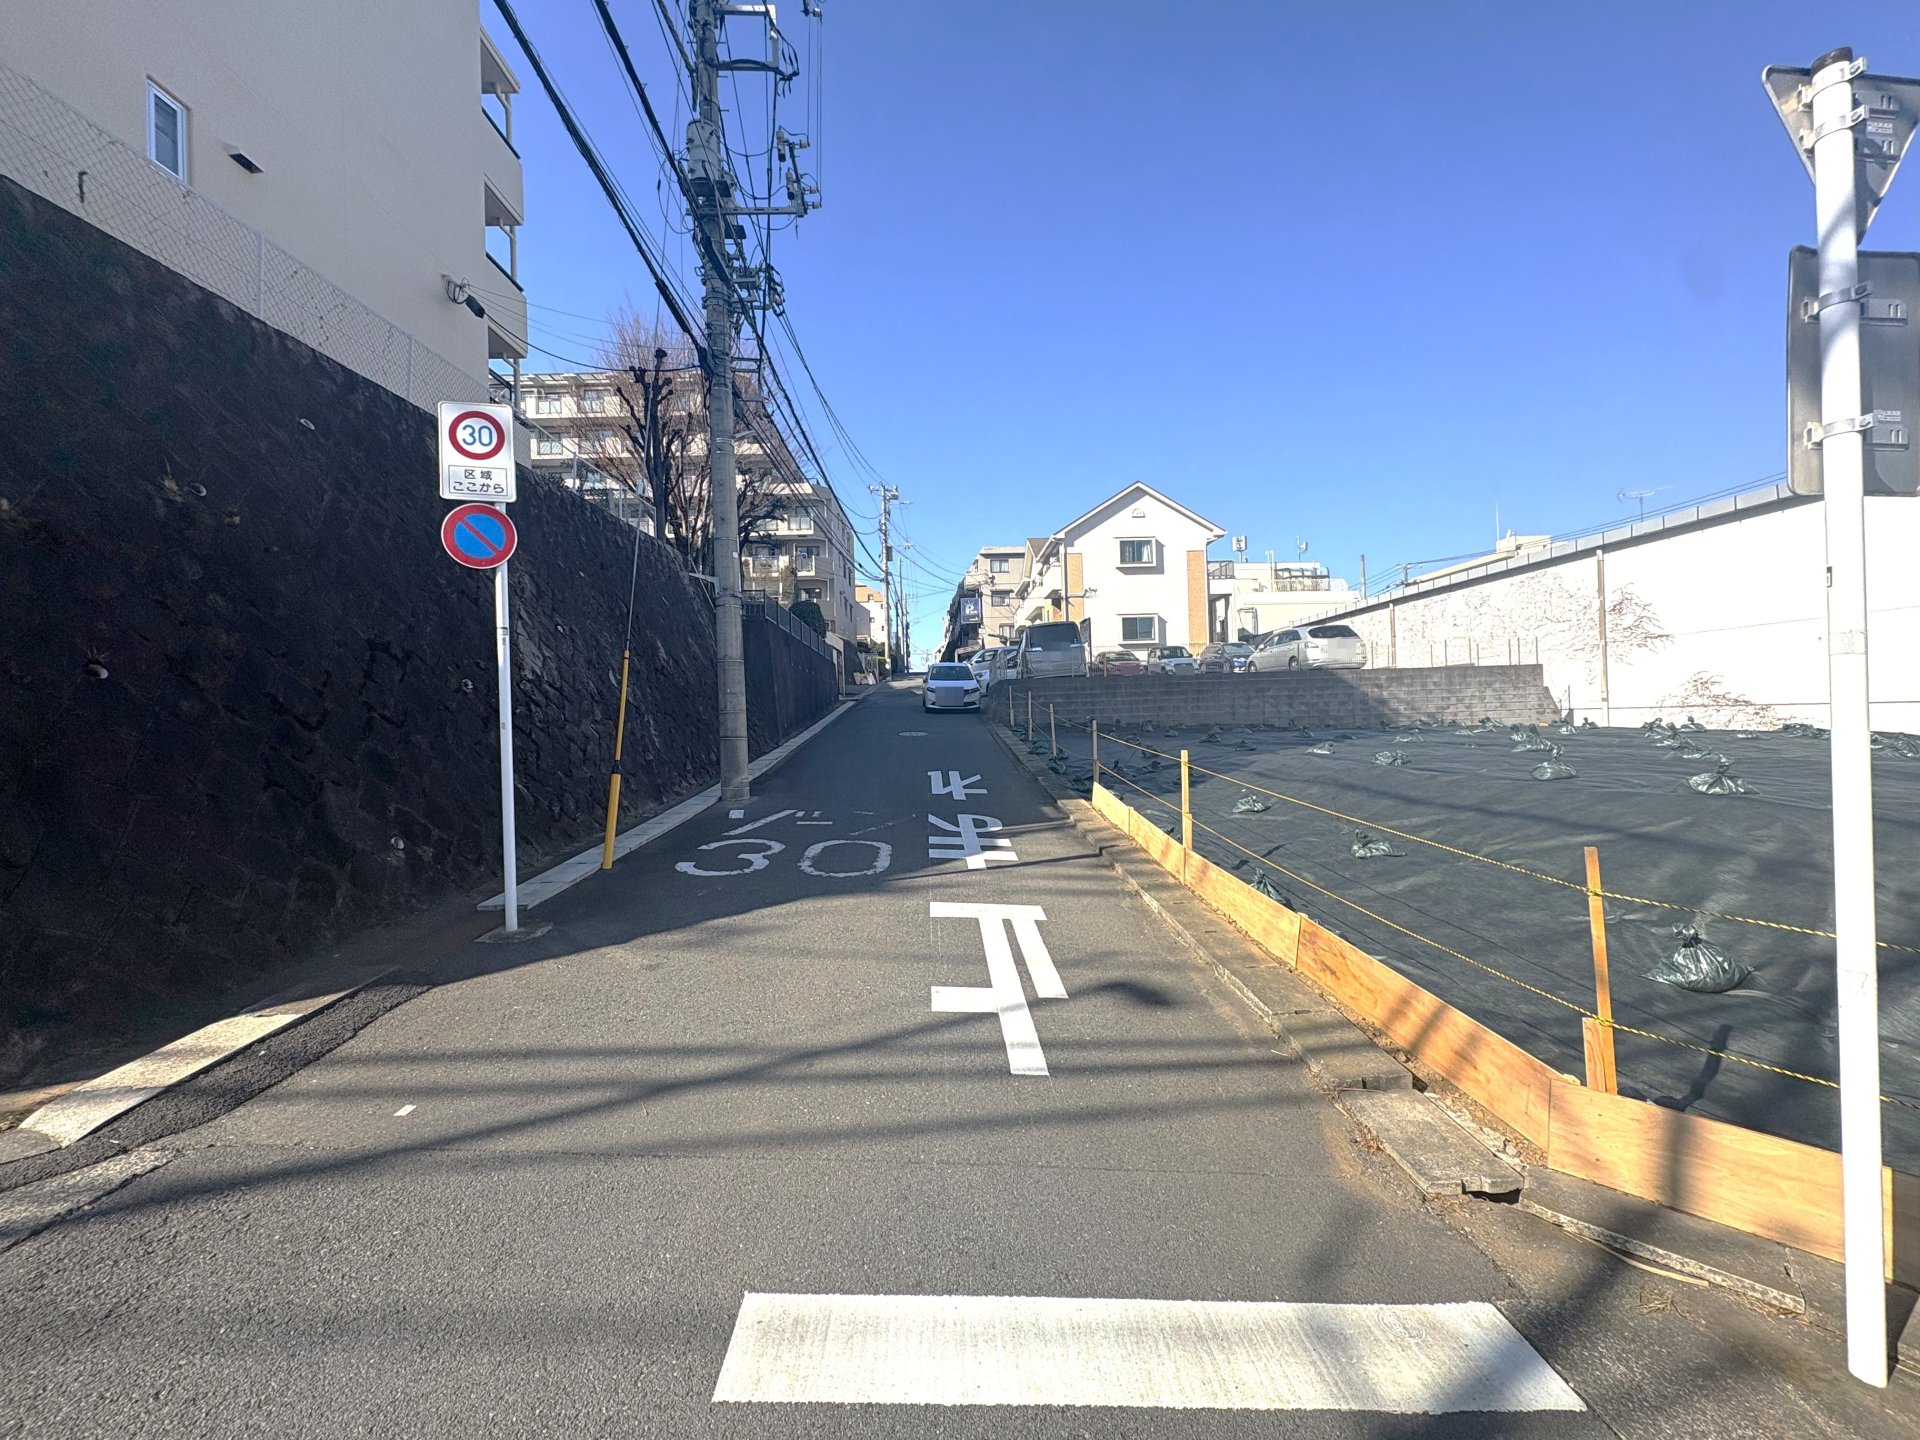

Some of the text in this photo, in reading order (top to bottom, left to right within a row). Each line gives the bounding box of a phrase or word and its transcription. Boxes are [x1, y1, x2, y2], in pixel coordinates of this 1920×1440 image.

[462, 424, 493, 447] 30
[464, 469, 493, 481] 区域
[452, 481, 505, 494] ここから
[674, 838, 893, 877] 30
